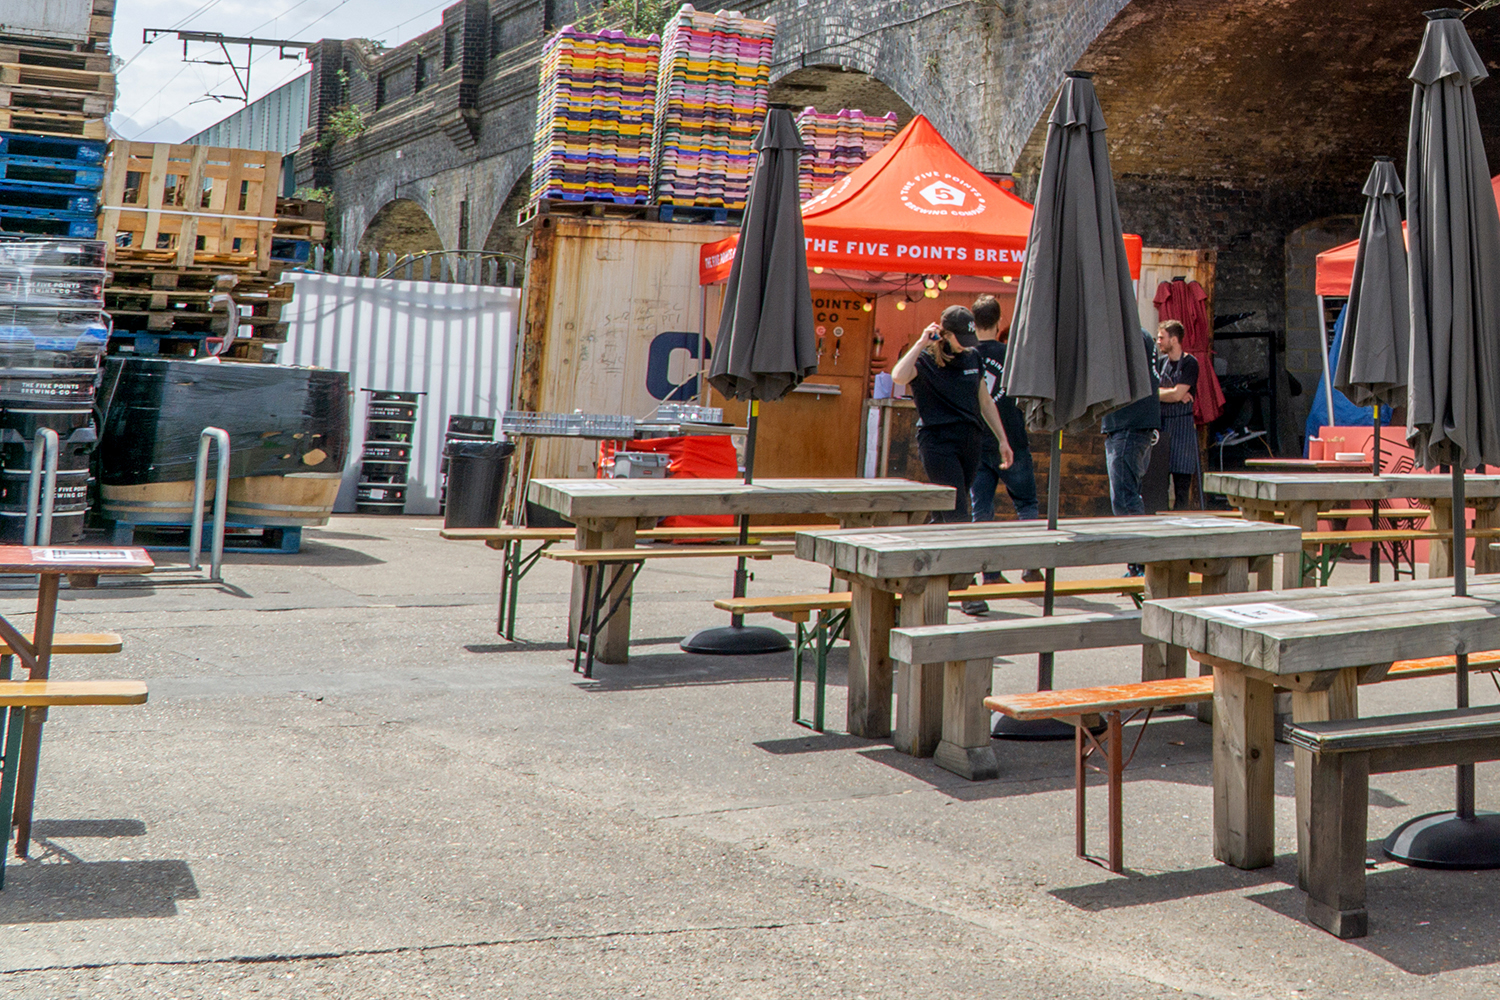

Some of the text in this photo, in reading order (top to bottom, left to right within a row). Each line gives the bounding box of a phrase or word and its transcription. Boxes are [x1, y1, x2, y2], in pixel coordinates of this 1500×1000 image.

[900, 171, 982, 197] THE FIVE POINTS
[934, 187, 955, 201] 5
[904, 201, 986, 216] BREWING COMPANY
[804, 238, 838, 253] THE
[846, 241, 889, 257] FIVE
[896, 245, 967, 261] POINTS
[812, 299, 862, 311] OINTS
[817, 312, 839, 323] CO
